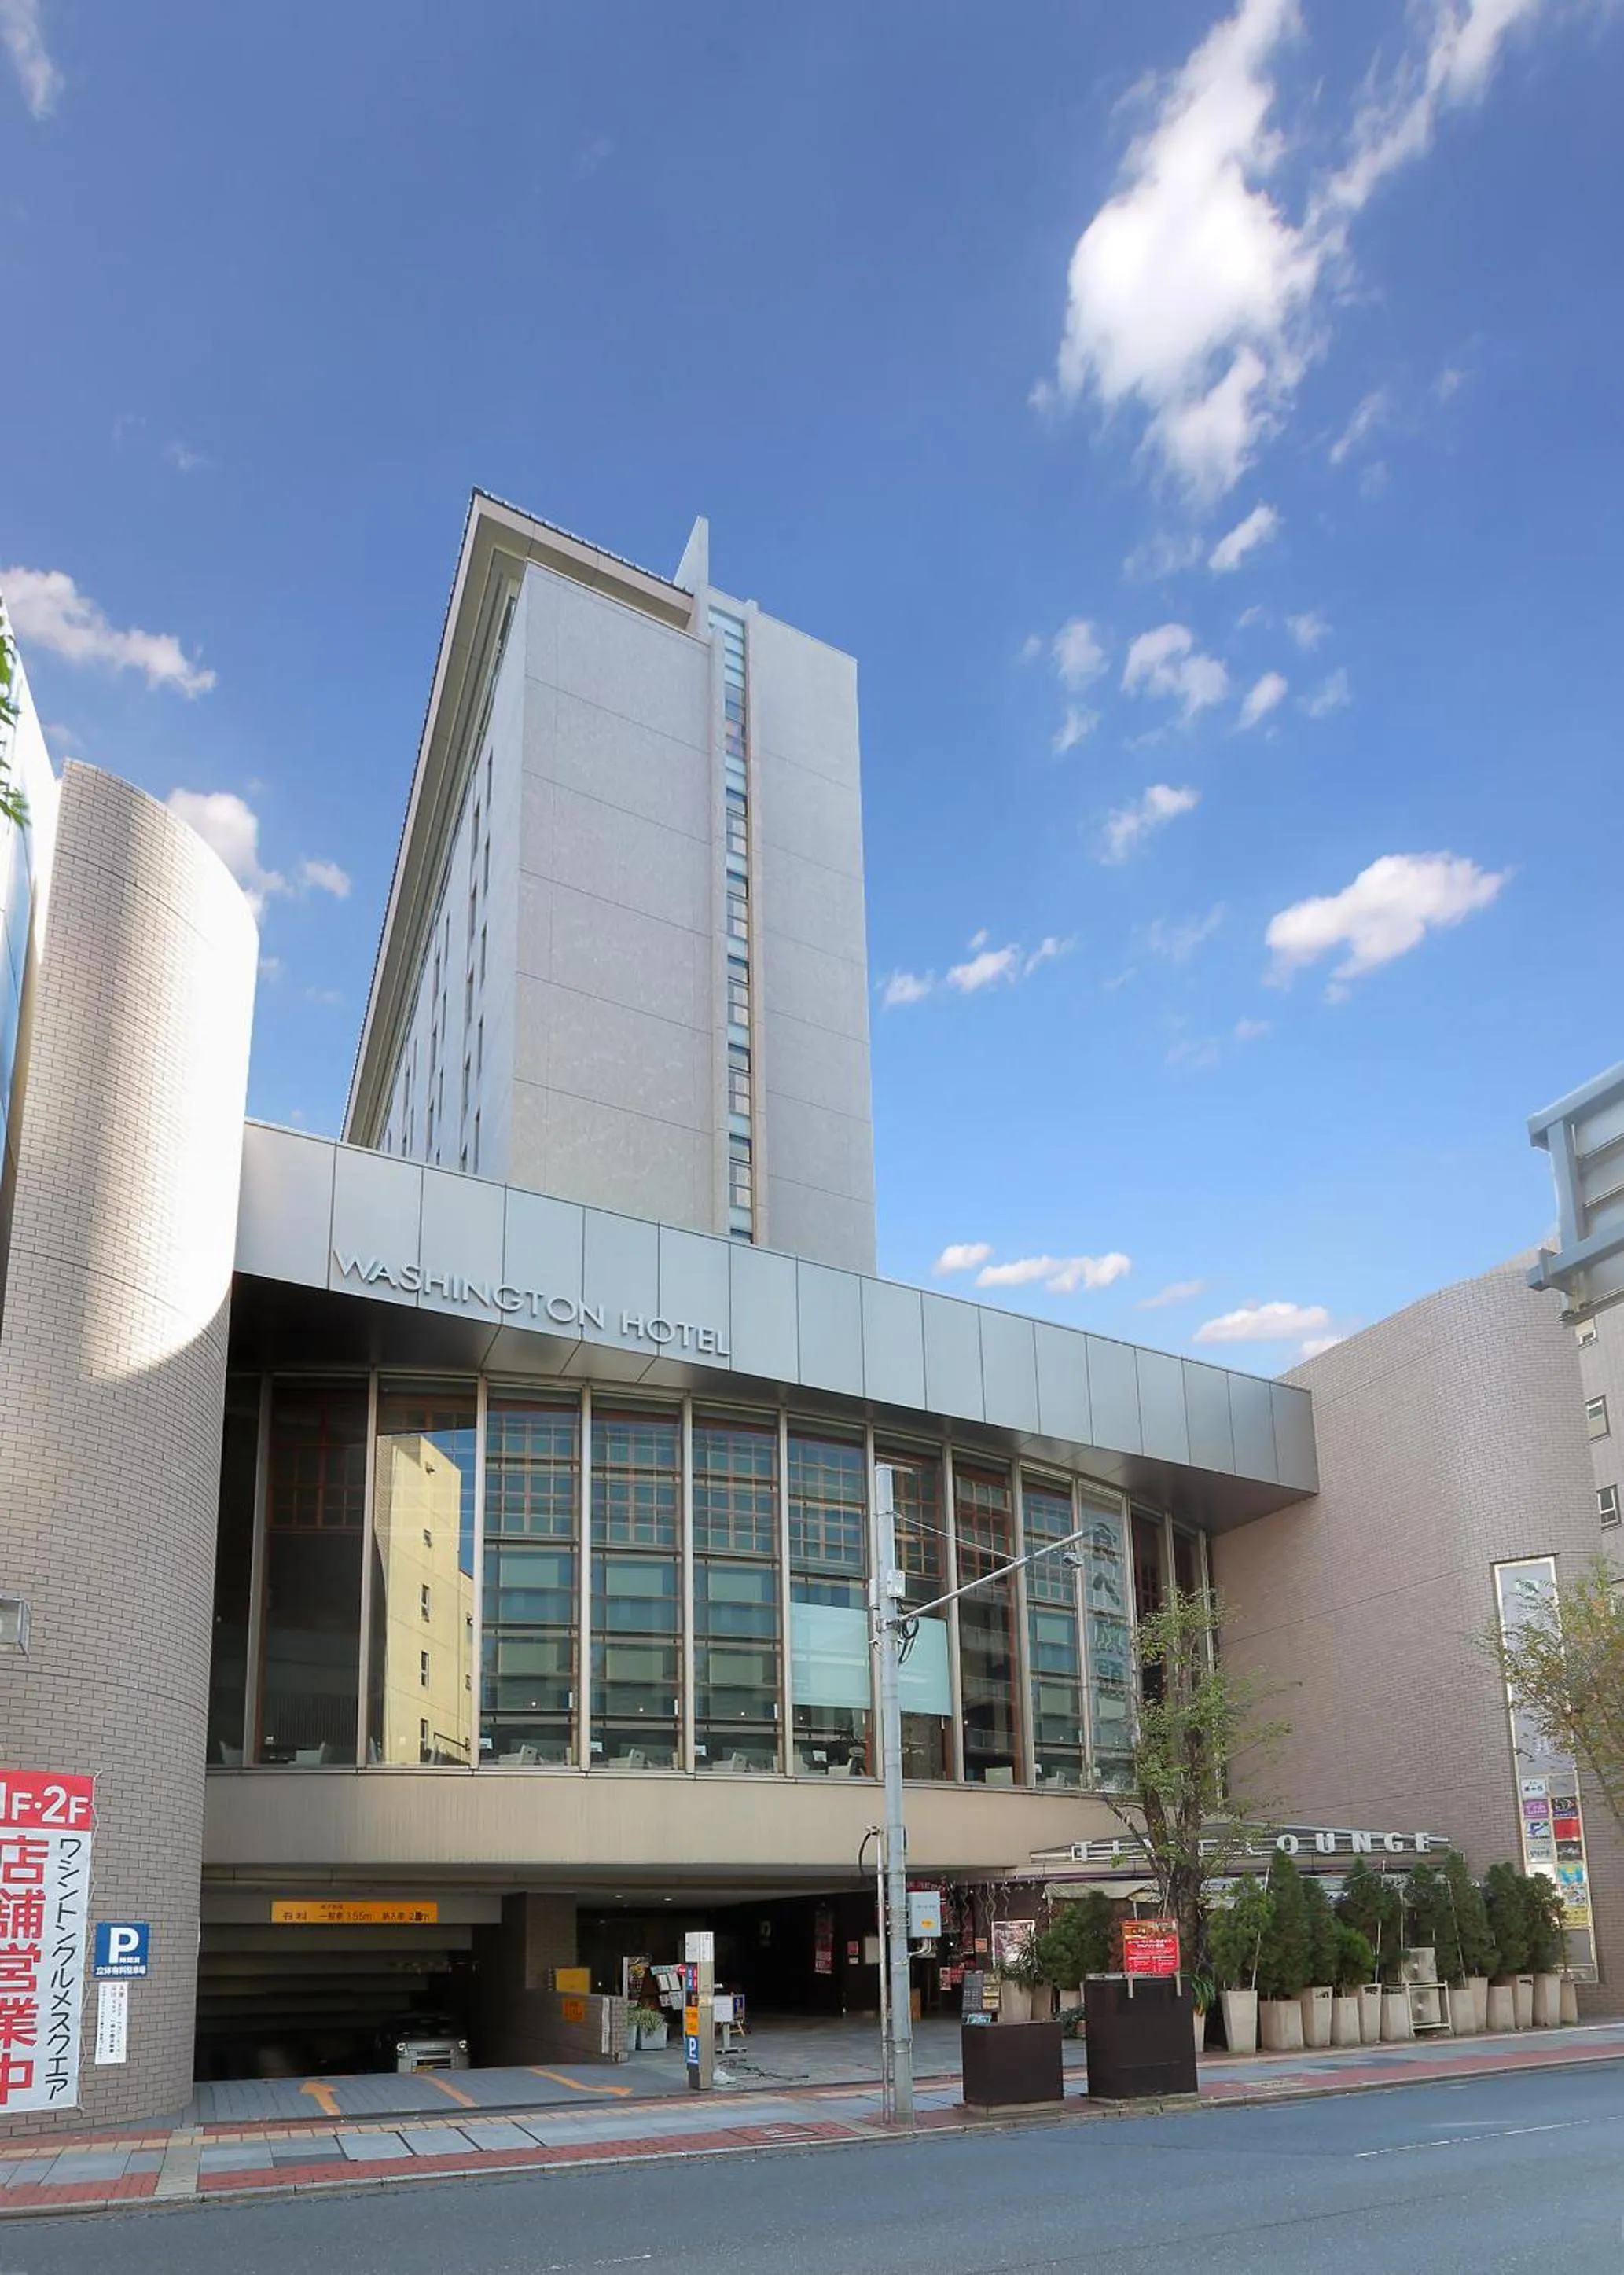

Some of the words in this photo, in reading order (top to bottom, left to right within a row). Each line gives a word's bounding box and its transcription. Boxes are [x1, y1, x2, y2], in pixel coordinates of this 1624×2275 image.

[333, 1248, 605, 1330] WASHINGTON
[620, 1309, 731, 1357] HOTEL
[108, 1927, 139, 1964] P
[689, 2038, 697, 2057] P
